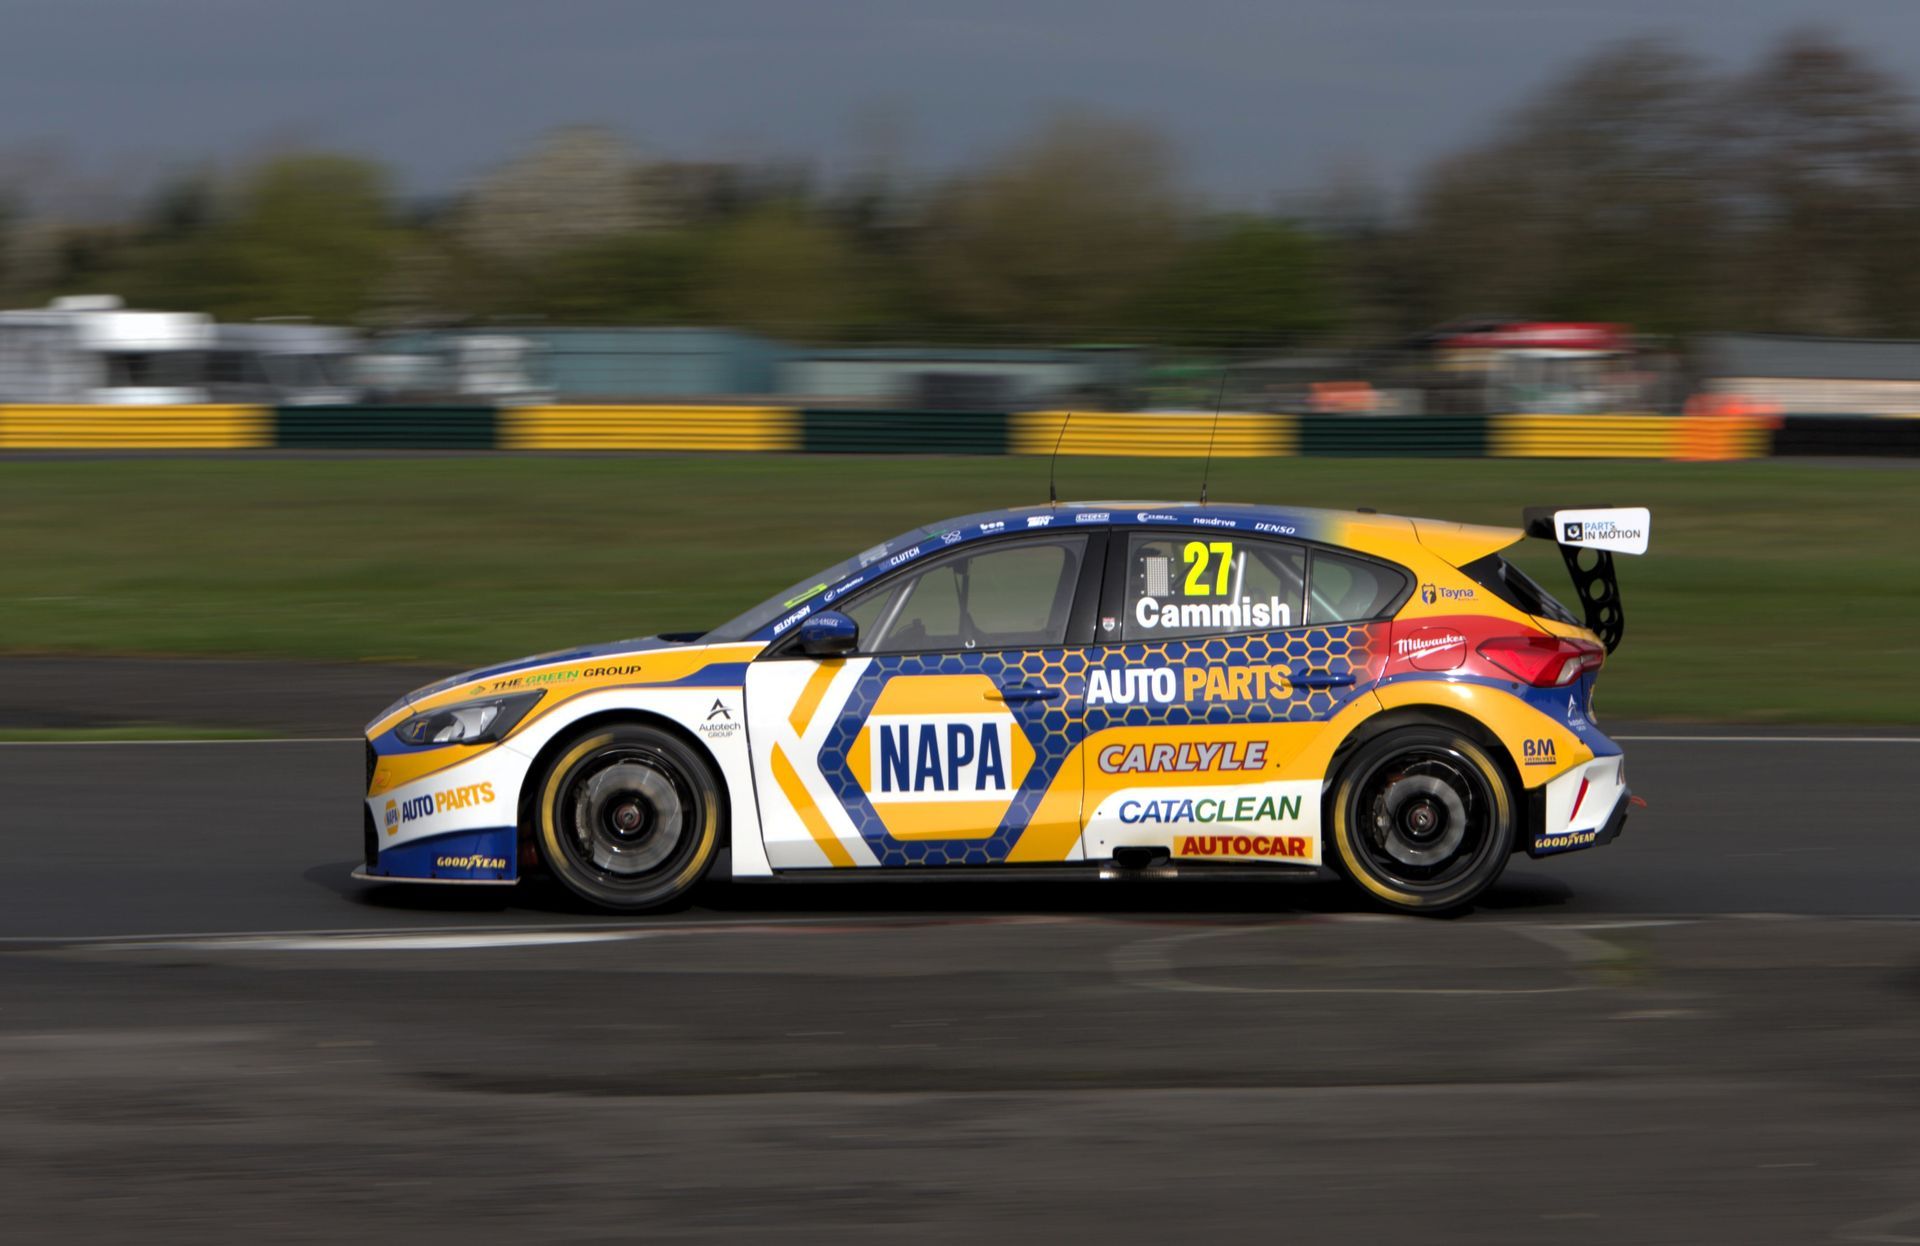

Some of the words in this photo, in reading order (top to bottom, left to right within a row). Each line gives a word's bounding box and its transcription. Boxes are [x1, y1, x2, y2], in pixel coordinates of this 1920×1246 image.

[1254, 522, 1296, 535] DENSO
[1584, 521, 1616, 532] PARTS
[1584, 531, 1596, 540] IN
[1598, 529, 1641, 540] MOTION
[890, 546, 920, 566] CLUTCH
[1183, 541, 1233, 596] 27
[1439, 587, 1474, 600] Tayna
[1136, 596, 1290, 629] Cammish
[493, 677, 523, 691] THE
[525, 669, 579, 685] GREEN
[583, 665, 642, 678] GROUP
[1086, 667, 1176, 704] AUTO
[1183, 664, 1294, 702] PARTS
[699, 721, 741, 732] Autotech
[879, 721, 1007, 793] NAPA
[1098, 740, 1270, 775] CARLYLE
[1523, 738, 1556, 757] BM
[401, 794, 434, 823] AUTO
[435, 781, 495, 814] PARTS
[1119, 794, 1303, 824] CATACLEAN
[1181, 836, 1306, 858] AUTOCAR
[1535, 832, 1596, 849] GOODYEAR
[437, 854, 506, 870] GOODYEAR
